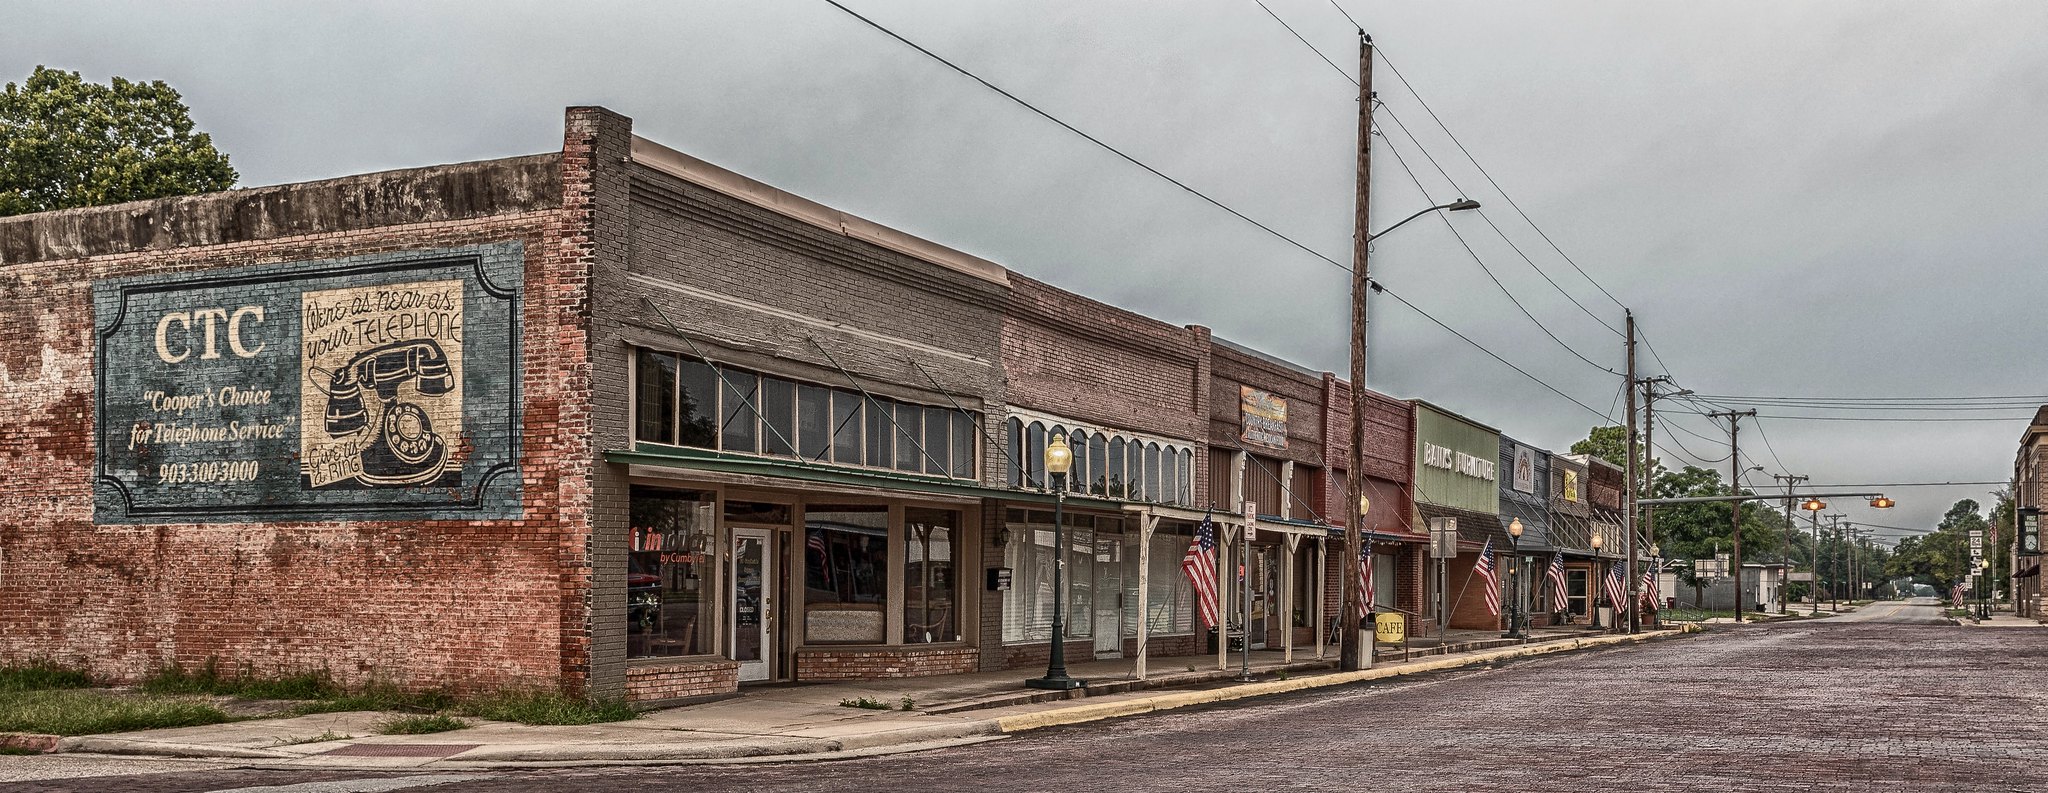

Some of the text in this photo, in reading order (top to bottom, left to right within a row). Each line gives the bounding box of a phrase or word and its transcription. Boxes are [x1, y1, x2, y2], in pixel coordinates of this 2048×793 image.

[306, 289, 455, 334] We're as near as
[155, 304, 265, 364] CTC
[306, 311, 462, 362] your TELEPHONE
[218, 385, 272, 407] Choice
[128, 415, 296, 451] for Telephone Service"
[158, 460, 260, 485] 903-300-3000
[310, 445, 341, 473] Give
[314, 456, 360, 485] a RING
[1455, 450, 1495, 481] FURNITURE
[660, 552, 671, 565] by
[1376, 621, 1404, 634] CAFE
